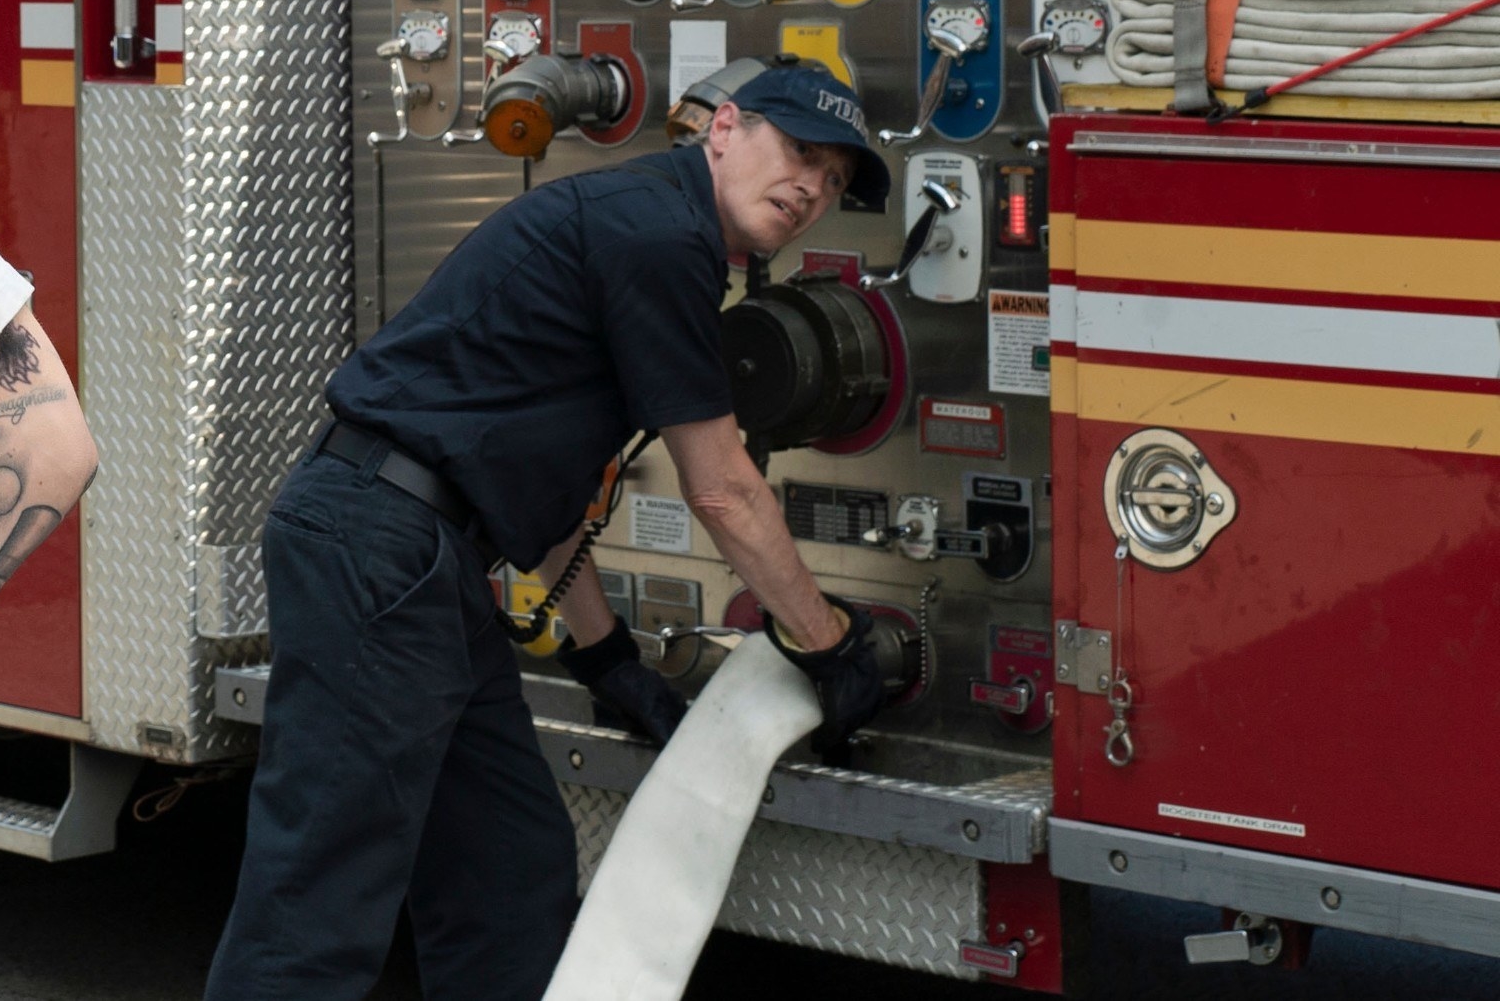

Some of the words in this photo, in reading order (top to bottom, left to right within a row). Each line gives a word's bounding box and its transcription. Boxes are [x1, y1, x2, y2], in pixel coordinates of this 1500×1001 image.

[935, 405, 988, 417] WATEROUS
[646, 500, 686, 513] WARNING
[1160, 805, 1222, 822] BOOSTER
[1226, 816, 1259, 827] TANK
[1262, 822, 1303, 834] DRAIN
